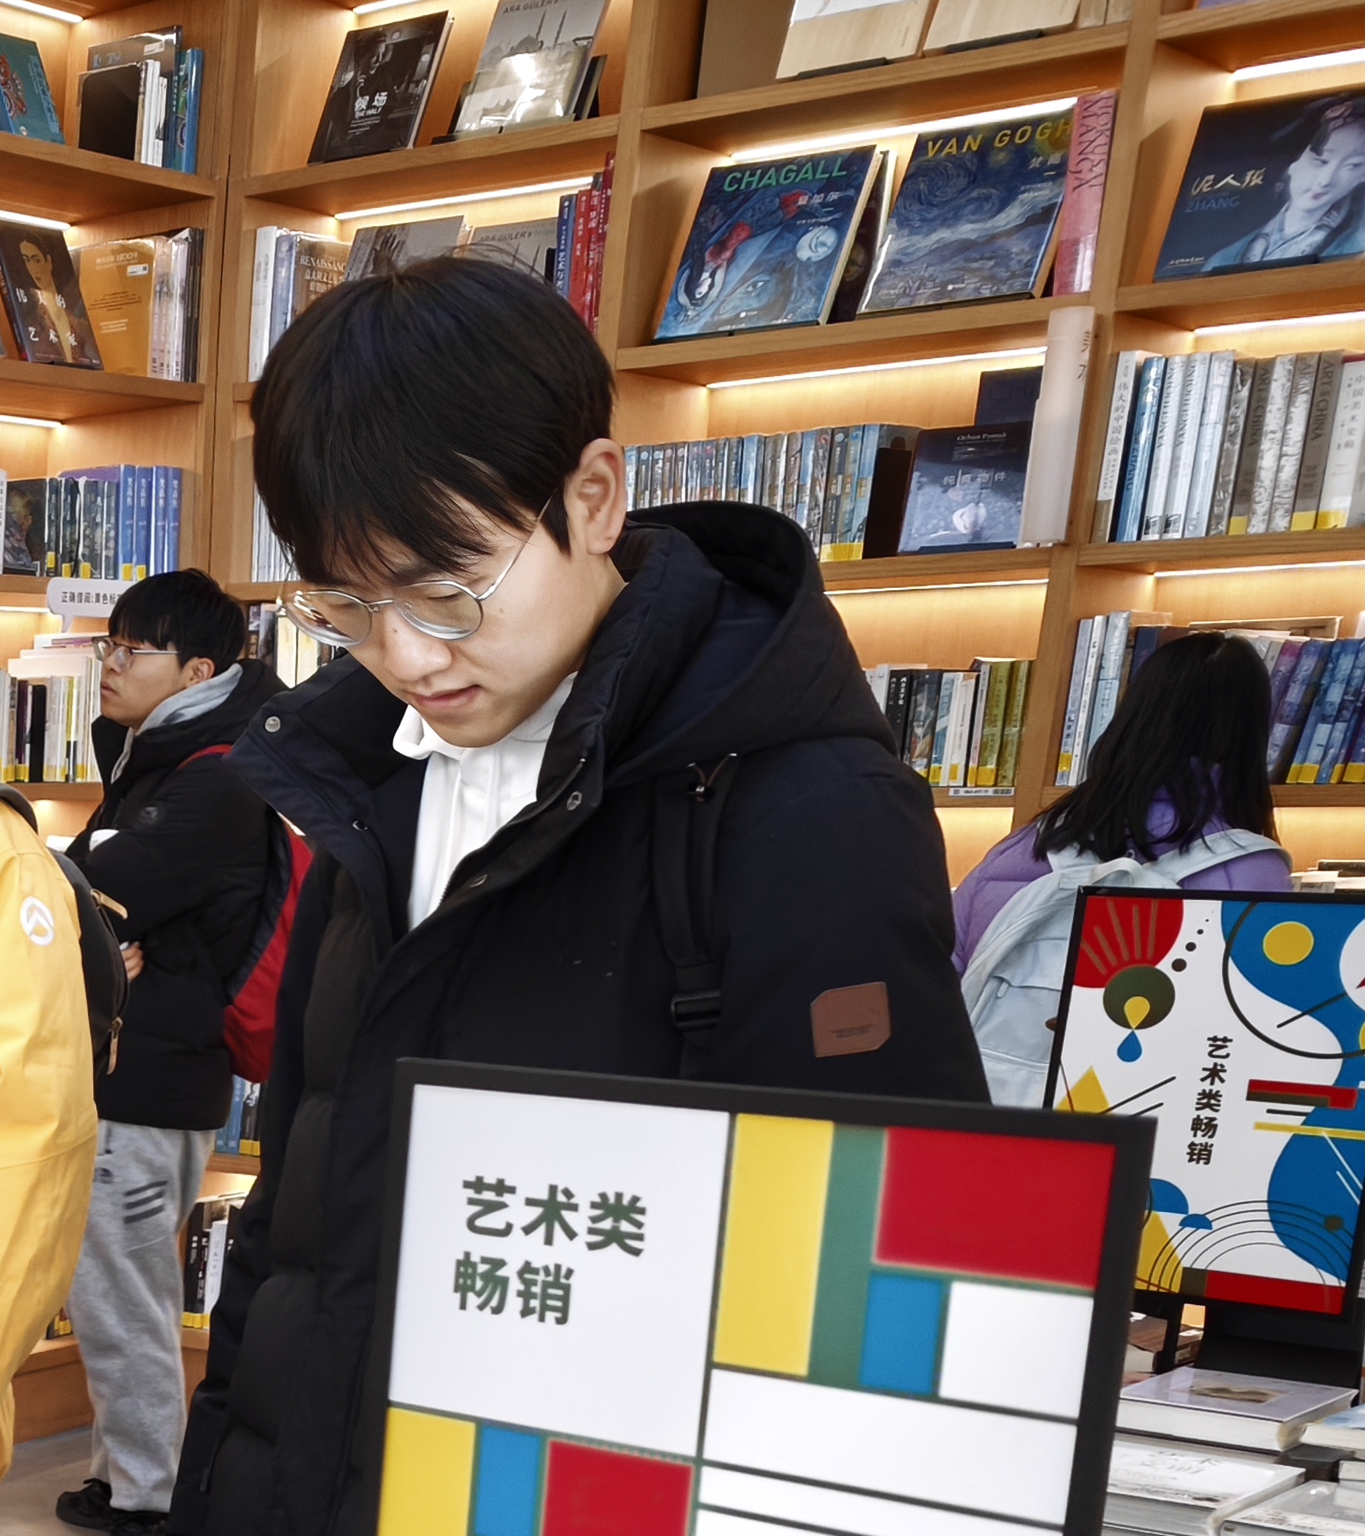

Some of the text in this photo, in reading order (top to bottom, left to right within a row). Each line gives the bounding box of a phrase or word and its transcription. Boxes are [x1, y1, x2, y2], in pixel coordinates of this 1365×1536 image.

[723, 157, 847, 194] CHAGALL
[926, 118, 1070, 160] VAN GOGH
[1186, 1035, 1235, 1168] 艺术类畅销
[462, 1174, 647, 1259] 艺术类
[453, 1251, 574, 1327] 畅销
